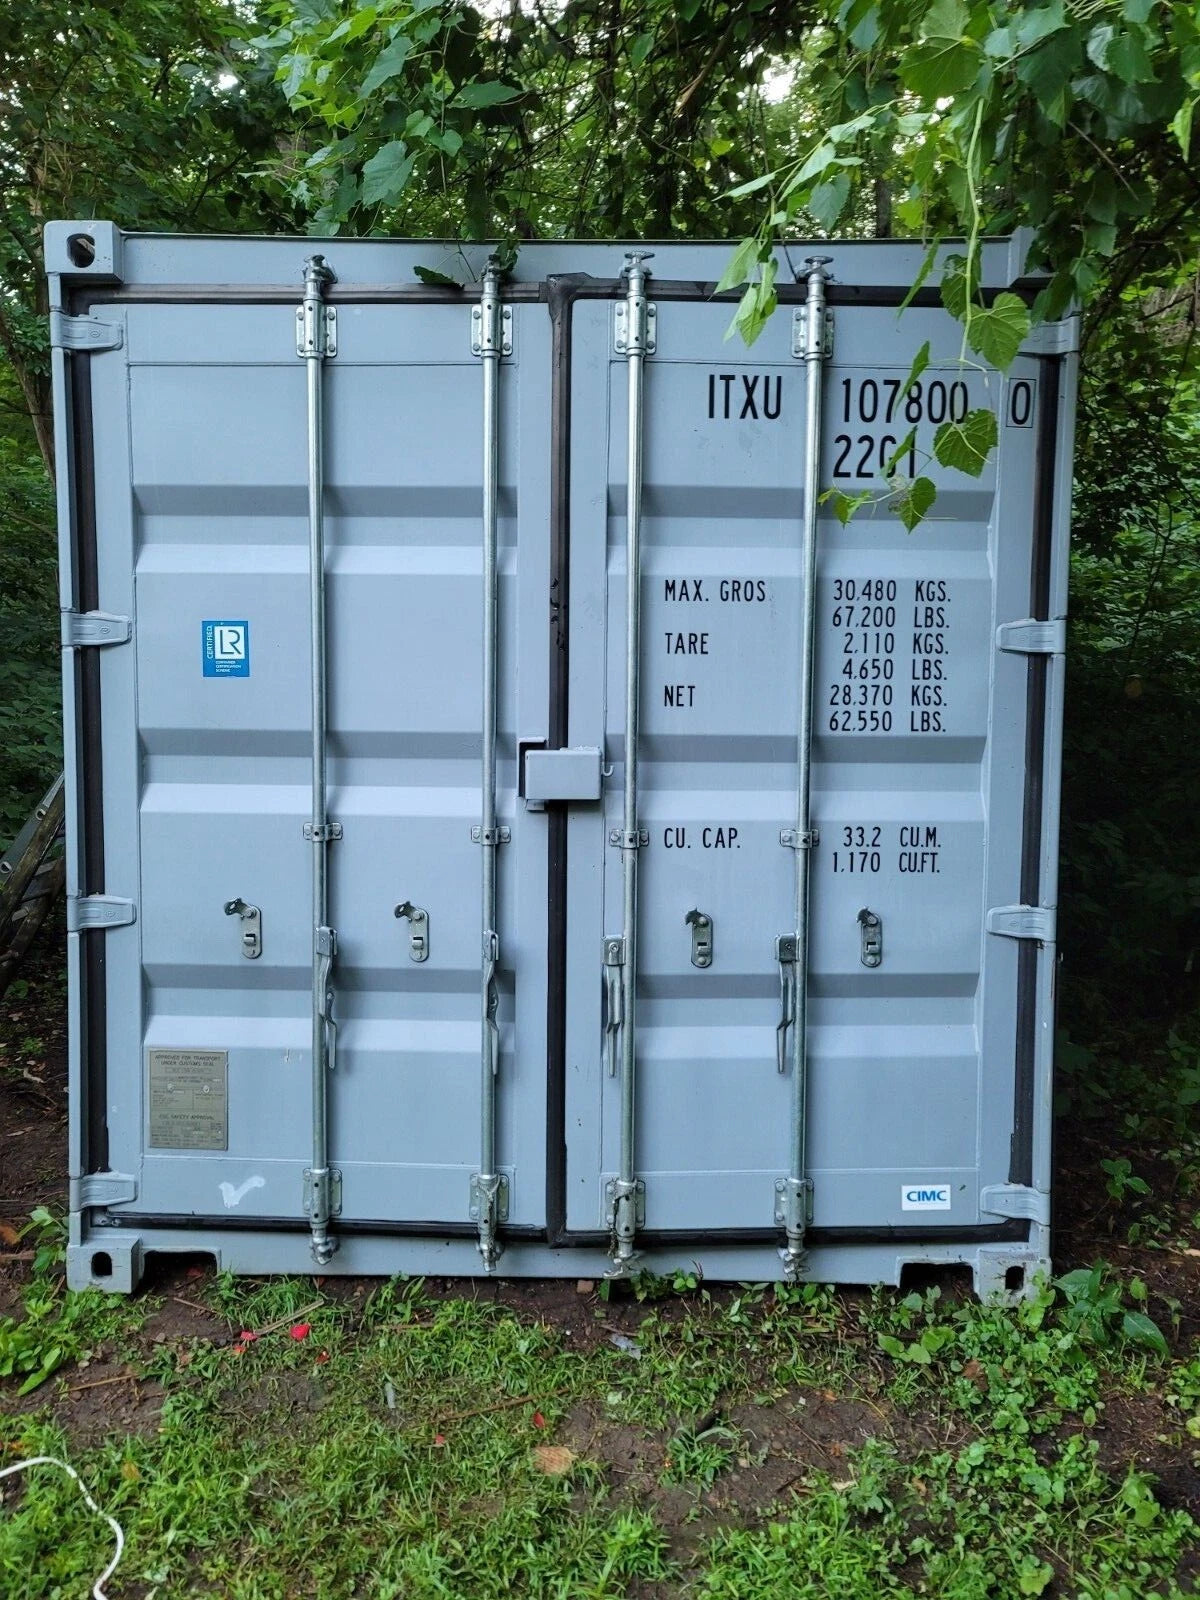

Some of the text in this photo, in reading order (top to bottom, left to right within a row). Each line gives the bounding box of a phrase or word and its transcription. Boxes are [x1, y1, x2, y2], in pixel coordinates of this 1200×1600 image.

[708, 374, 1031, 425] ITXU 107800 0
[664, 580, 709, 602] MAX.
[915, 580, 951, 602] KGS.
[833, 606, 950, 629] 67,200 LBS.
[220, 630, 242, 654] LR
[665, 632, 949, 655] TARE 2,110 KGS.
[842, 658, 947, 681] 4,650 LBS.
[664, 684, 947, 707] NET 28,370 KGS.
[829, 710, 946, 733] 62,550 LBS.
[664, 826, 942, 849] CU. CAP. 33.2 CU.M.
[832, 851, 940, 873] 1,170 CU.FT.
[906, 1190, 947, 1202] CIMC
